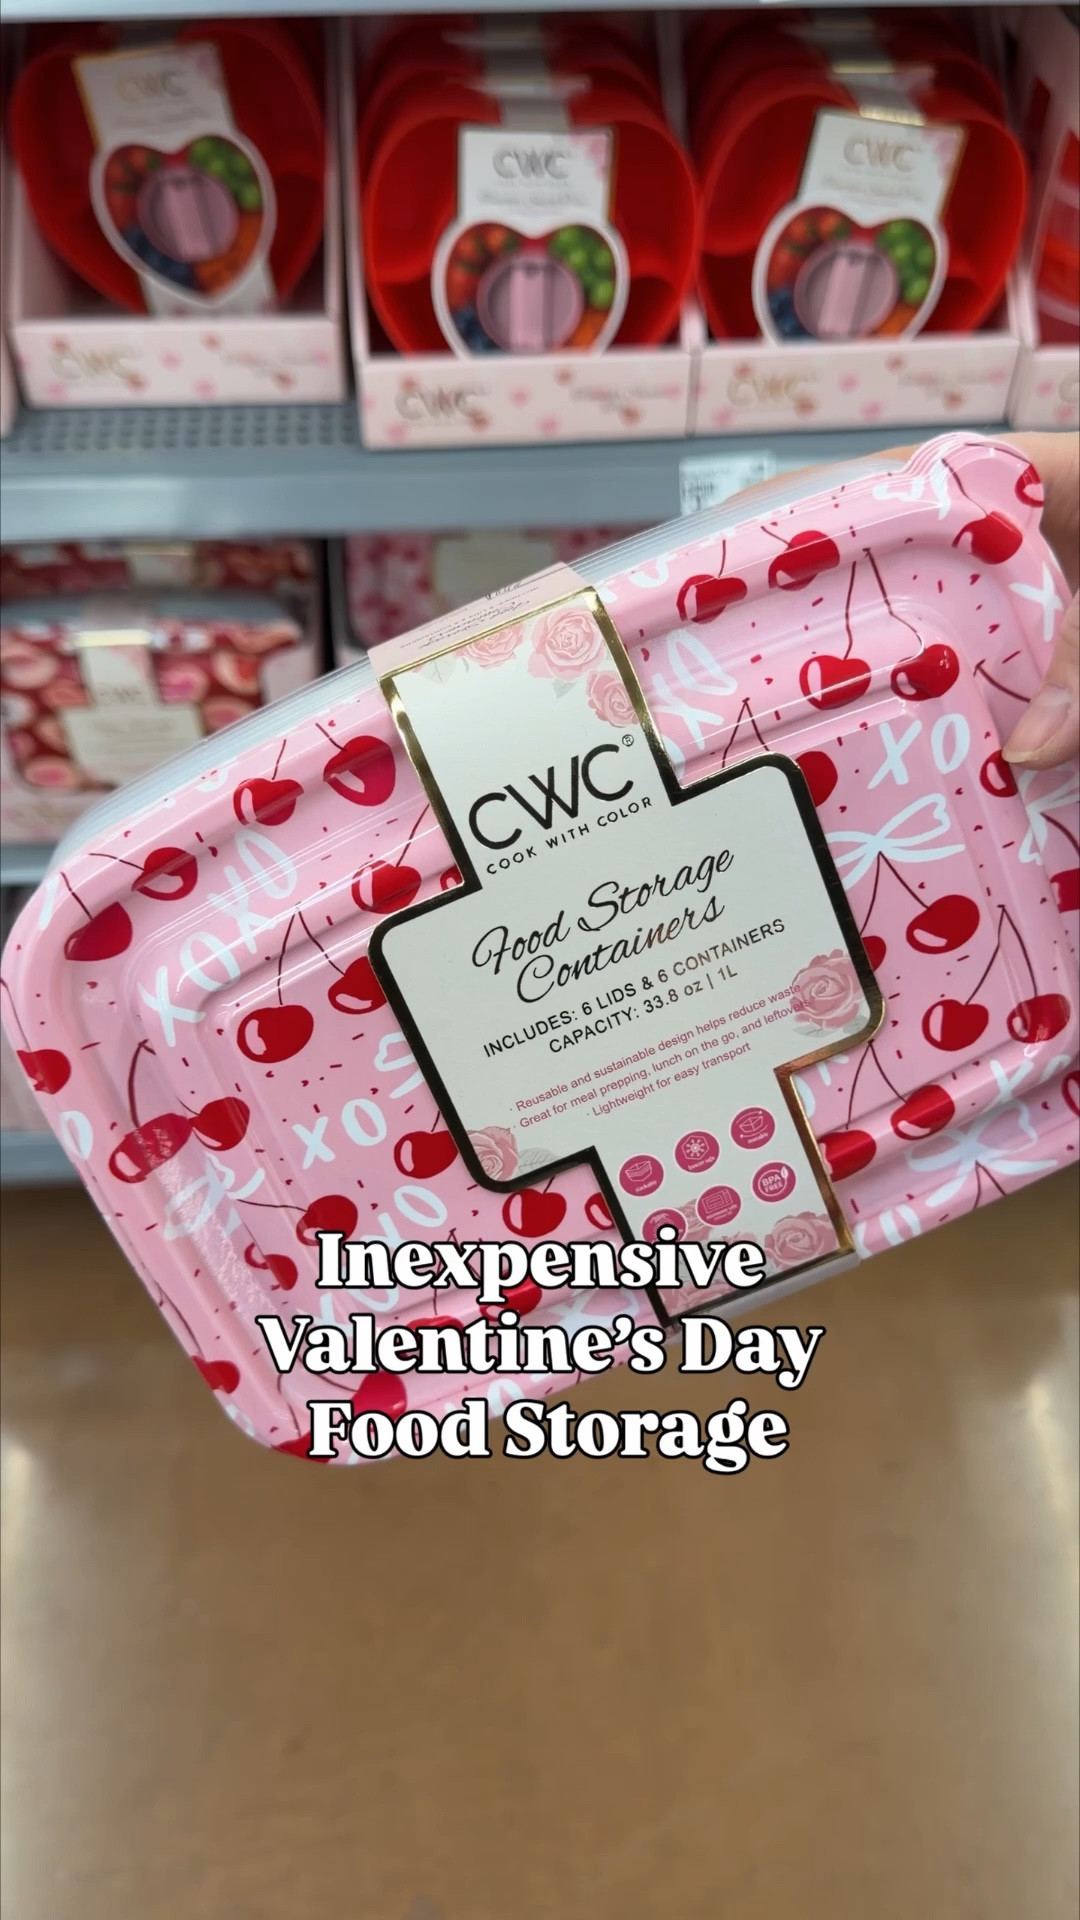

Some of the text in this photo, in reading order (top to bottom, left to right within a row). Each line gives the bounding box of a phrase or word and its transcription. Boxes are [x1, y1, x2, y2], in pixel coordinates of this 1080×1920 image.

[867, 713, 971, 790] XO
[487, 797, 652, 874] COOK WITH COLOR
[136, 829, 299, 1048] XOXO
[472, 850, 734, 975] Food Storage
[517, 879, 725, 1003] Containers
[484, 919, 784, 1057] INCLUDES: 6 LIDS & 6 CONTAINERS
[550, 1007, 639, 1052] CAPACITY:
[644, 989, 678, 1013] 33.8
[684, 981, 703, 996] oz
[718, 965, 738, 980] 1L
[516, 985, 801, 1111] Reusable and sustainable design helps reduce waste
[520, 1109, 551, 1127] Great
[553, 1103, 567, 1114] for
[571, 1089, 597, 1107] meal
[600, 1070, 651, 1097] prepping,
[652, 1054, 682, 1072] lunch
[685, 1048, 699, 1058] on
[701, 1039, 719, 1051] the
[721, 1032, 739, 1044] go,
[741, 1018, 762, 1034] and
[592, 1042, 751, 1116] Lightweight for easy transport
[293, 1098, 387, 1170] XO
[762, 1173, 782, 1187] BPA
[765, 1181, 784, 1194] FREE
